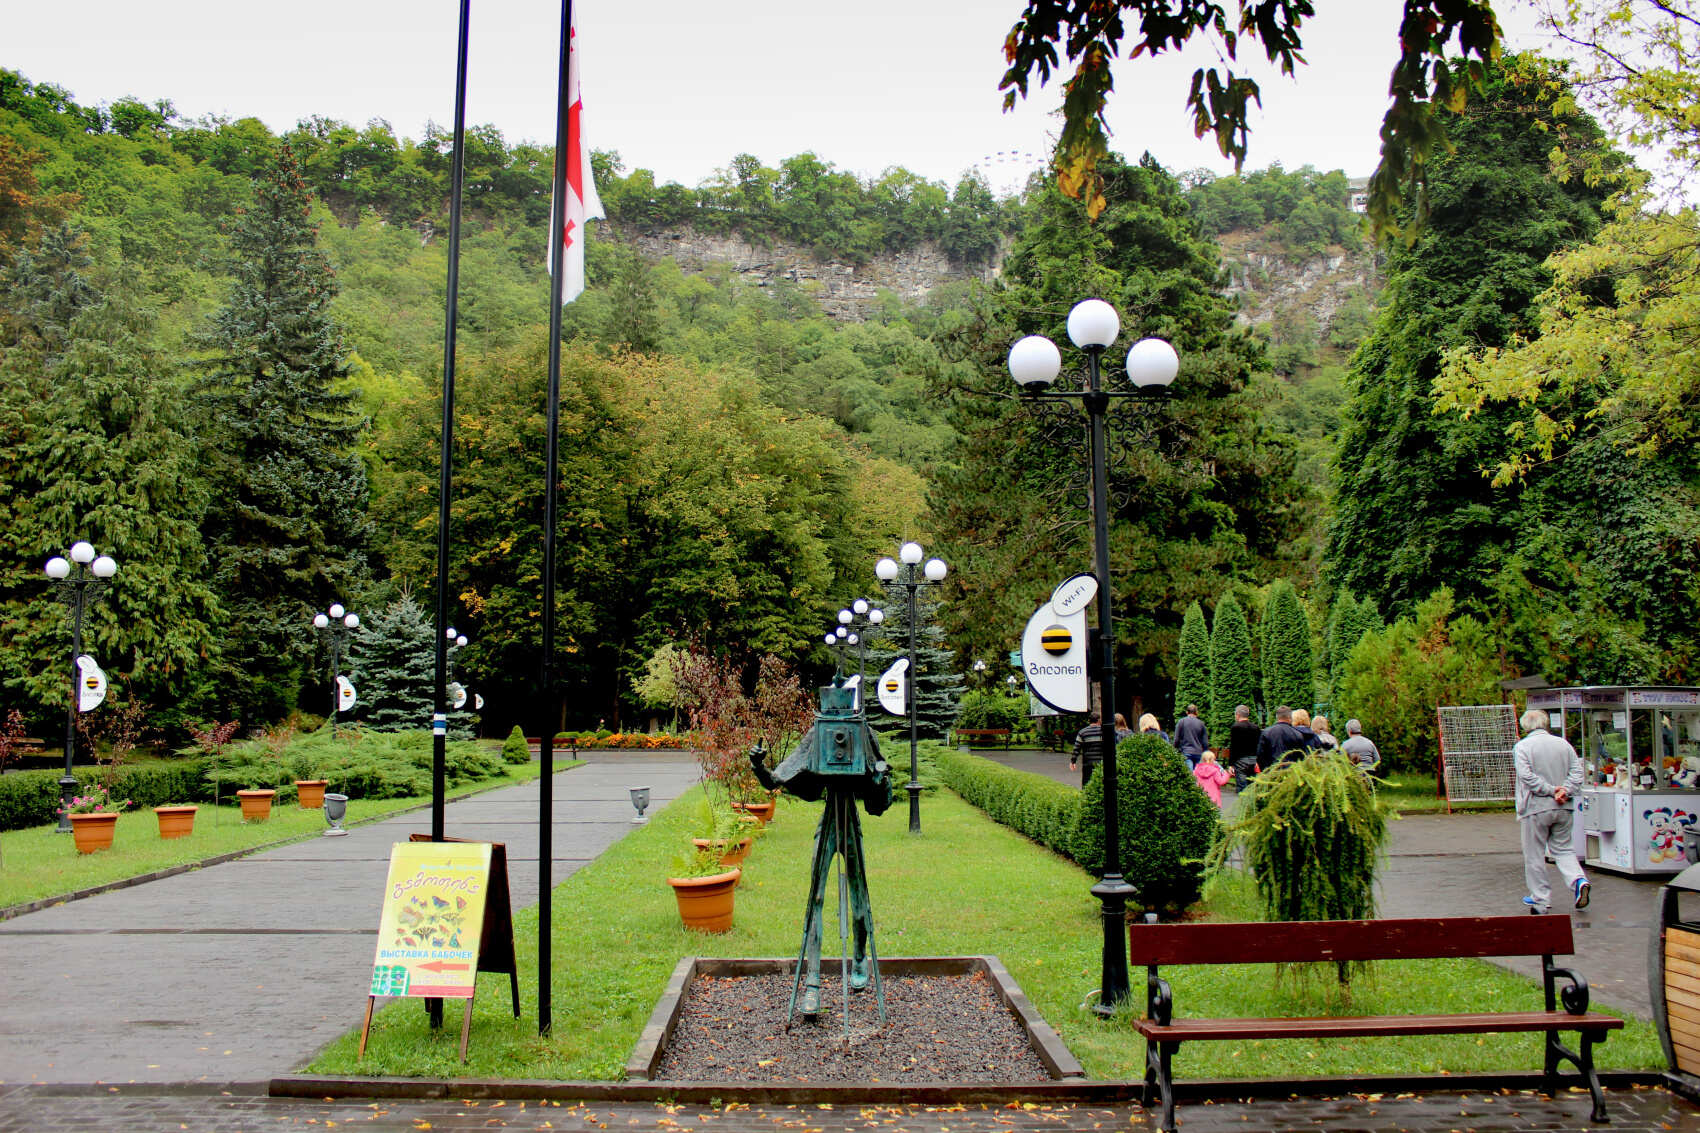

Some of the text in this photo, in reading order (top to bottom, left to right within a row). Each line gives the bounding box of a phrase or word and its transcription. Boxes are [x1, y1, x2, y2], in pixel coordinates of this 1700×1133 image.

[1062, 585, 1086, 607] WI-FI
[380, 949, 473, 960] ВЫСТАВКА БАБОЧЕК
